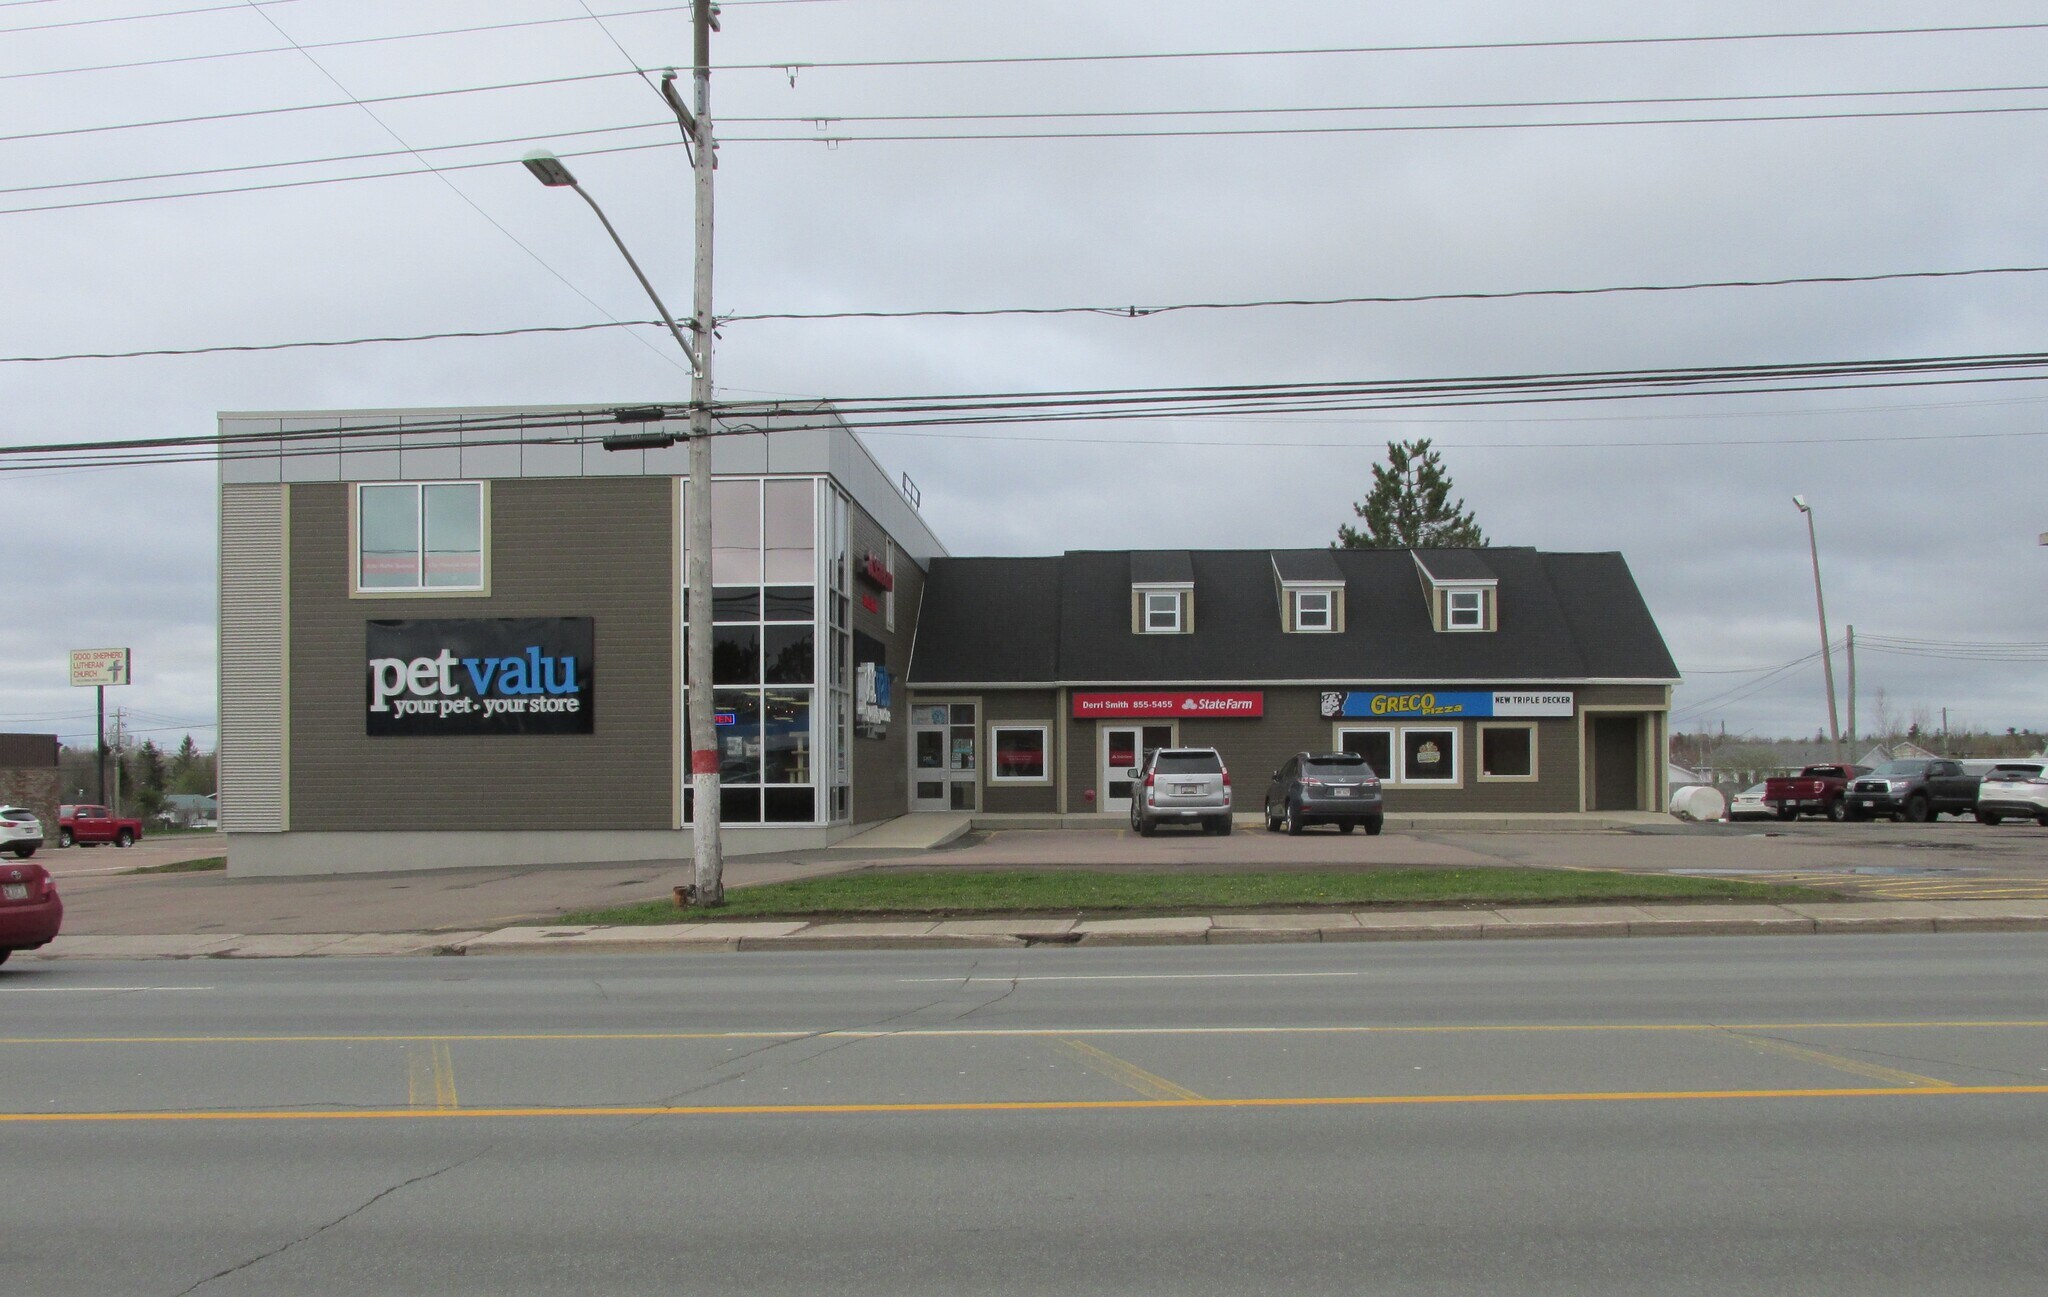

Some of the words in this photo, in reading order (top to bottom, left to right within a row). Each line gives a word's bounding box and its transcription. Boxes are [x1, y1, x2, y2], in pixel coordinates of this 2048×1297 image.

[73, 652, 91, 660] GOOD
[93, 651, 123, 660] SHEPHERD
[73, 661, 105, 670] LUTHERAN
[73, 670, 97, 678] CHURCH
[370, 648, 460, 712] pet
[462, 645, 580, 696] valu
[1082, 701, 1103, 709] Derri
[1105, 701, 1129, 709] Smith
[1133, 700, 1173, 709] 855-5455
[1370, 693, 1435, 715] GRECO
[1495, 696, 1511, 704] NEW
[1513, 696, 1540, 704] TRIPLE
[1542, 696, 1571, 704] DECKER
[394, 698, 438, 719] your
[440, 696, 473, 719] pet
[483, 698, 528, 718] your
[529, 695, 580, 713] store
